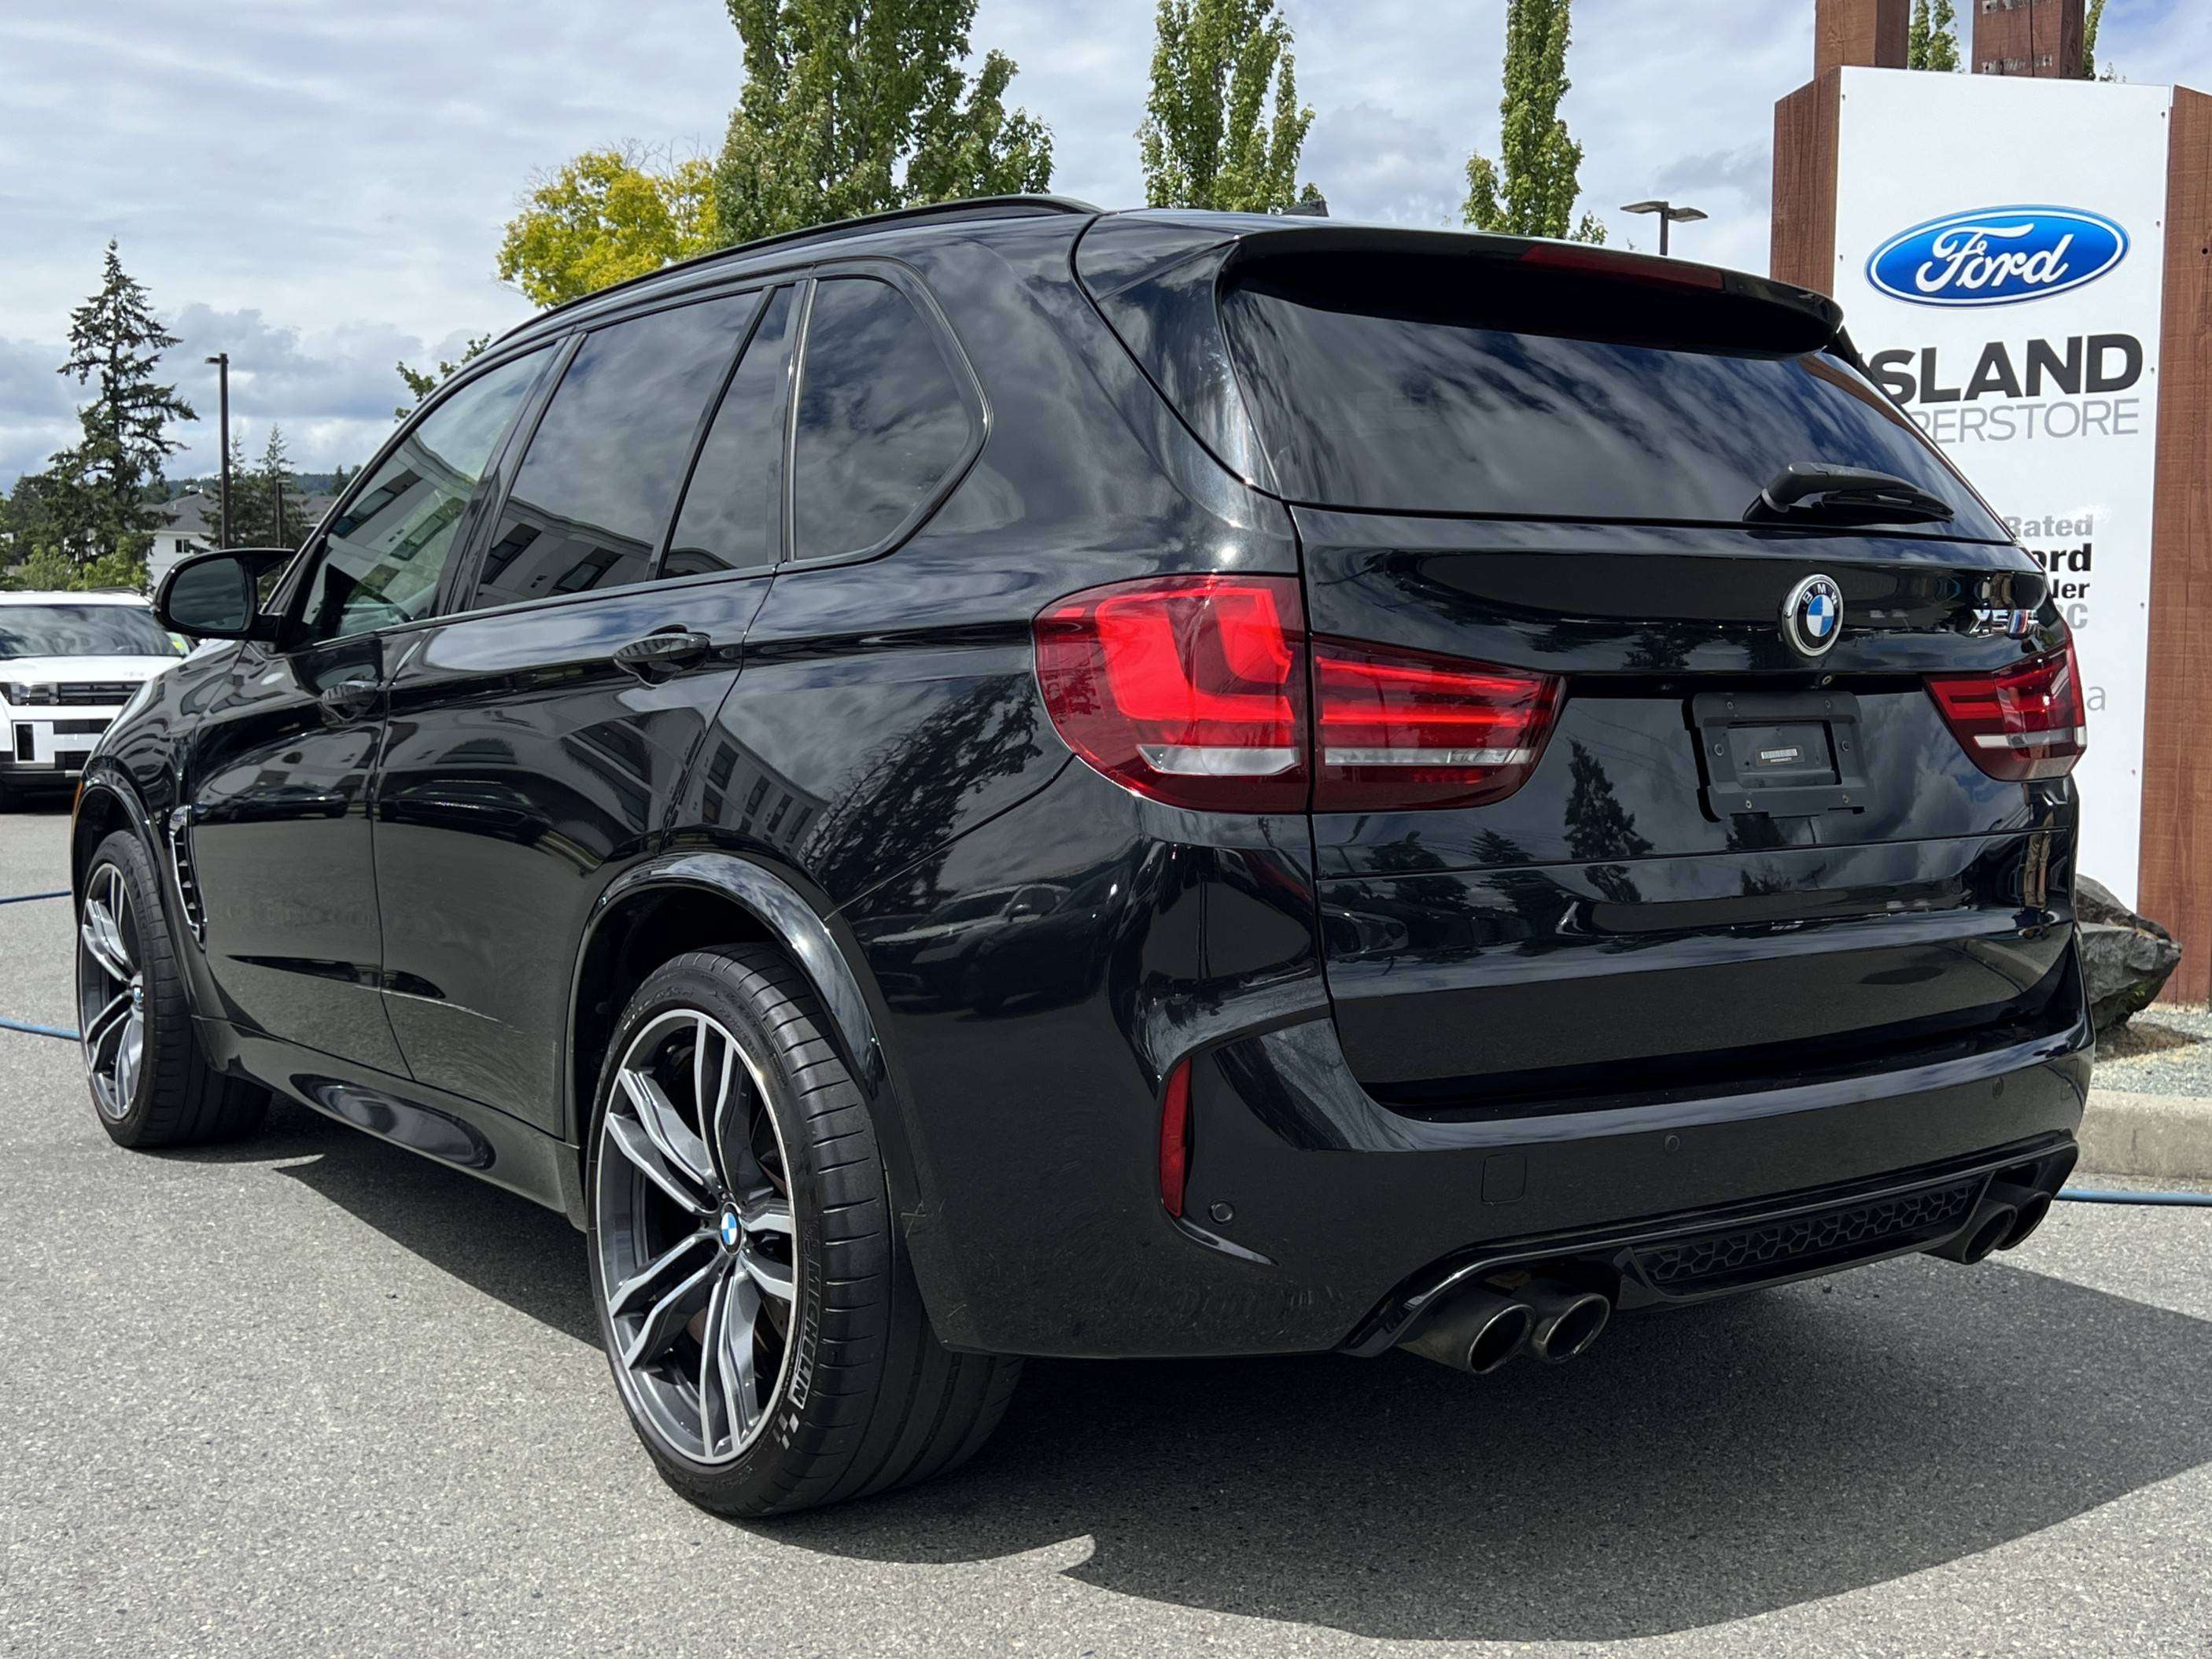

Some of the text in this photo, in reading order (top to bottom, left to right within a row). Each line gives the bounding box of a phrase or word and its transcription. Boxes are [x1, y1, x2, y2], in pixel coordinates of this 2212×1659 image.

[1915, 223, 2074, 293] Ford
[1856, 334, 2143, 405] SLAND
[1909, 398, 2140, 444] PERSTORE
[2004, 514, 2093, 537] Rated
[2031, 543, 2092, 573] ord
[787, 1258, 822, 1410] MICHELIN
